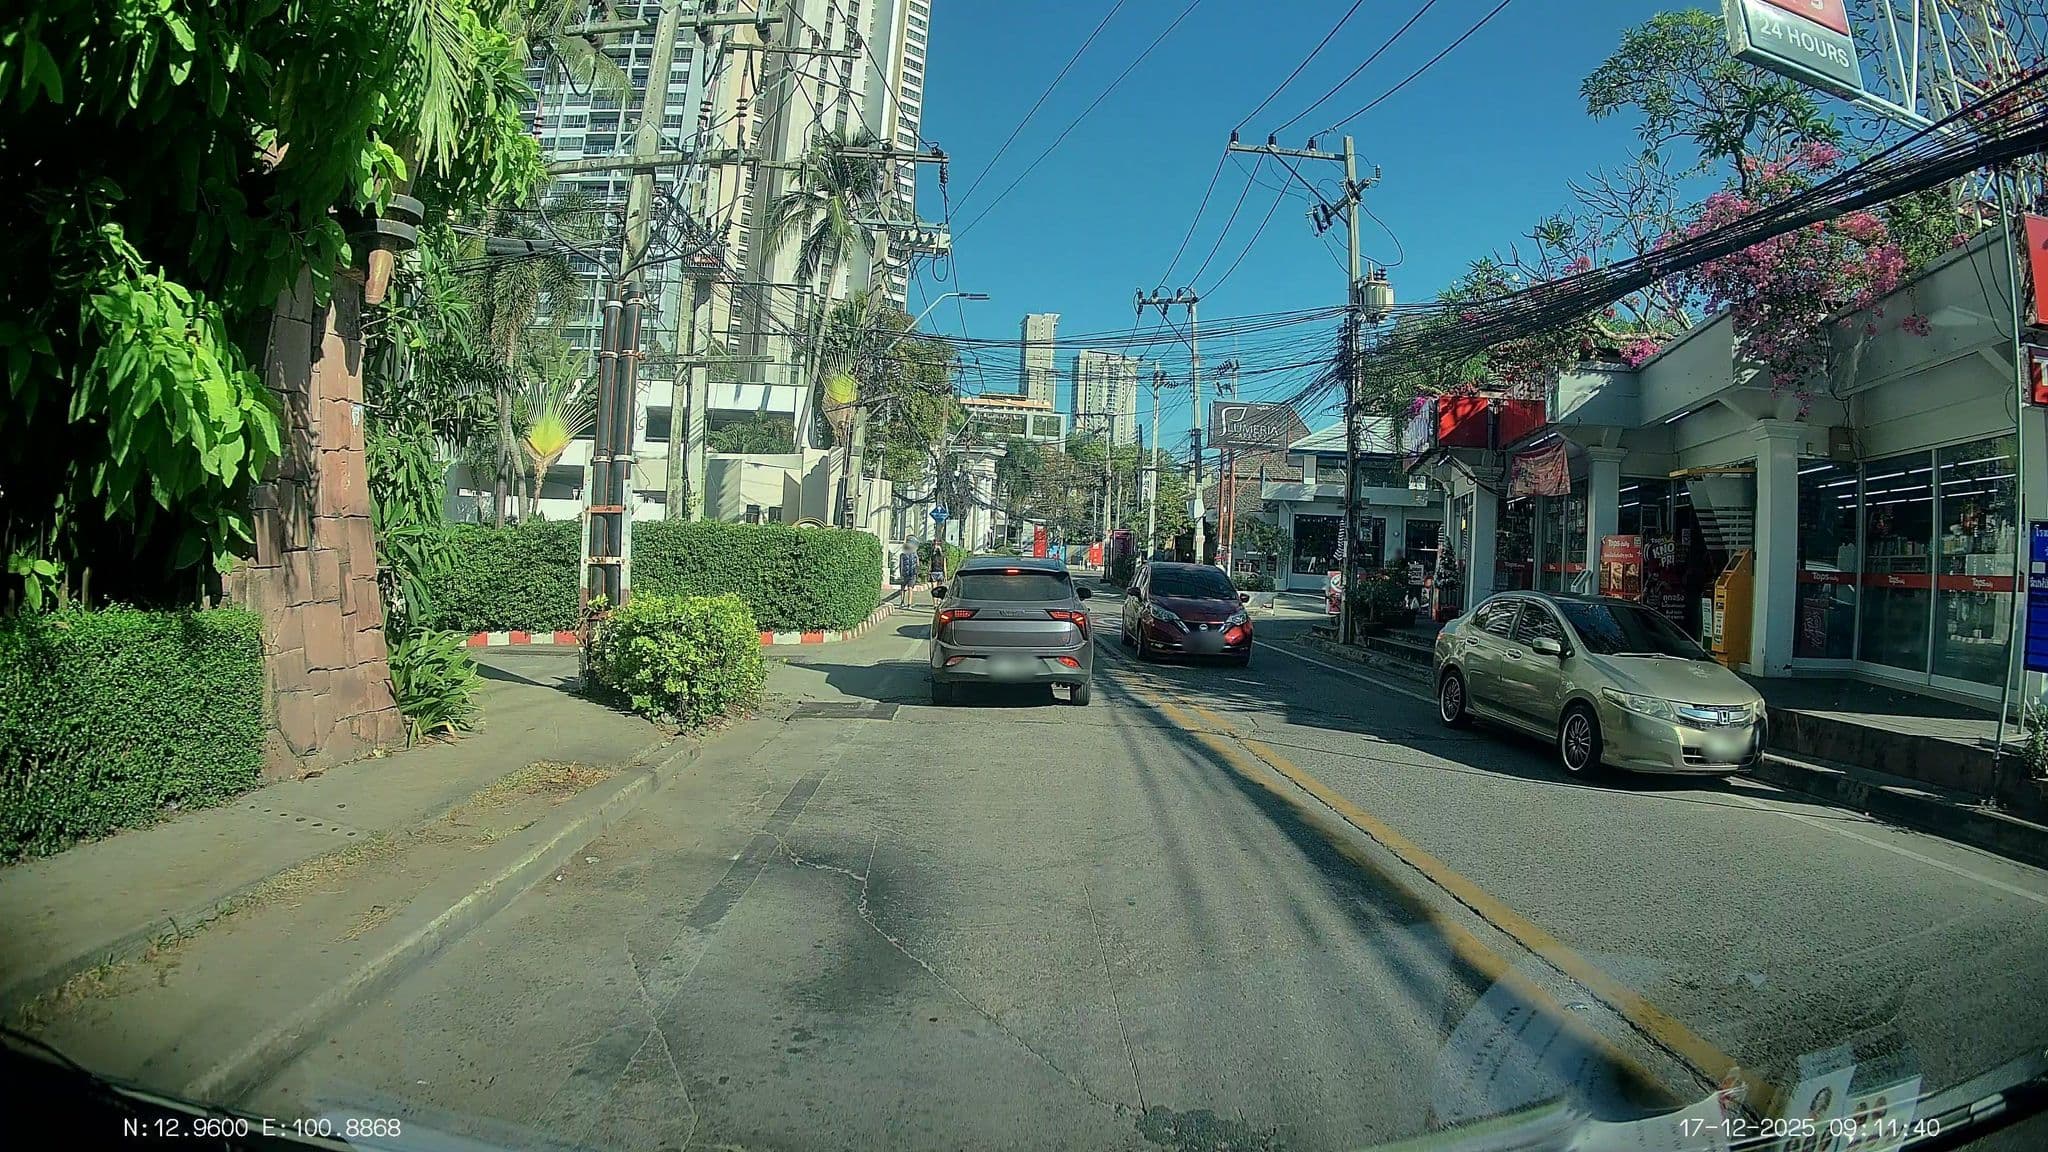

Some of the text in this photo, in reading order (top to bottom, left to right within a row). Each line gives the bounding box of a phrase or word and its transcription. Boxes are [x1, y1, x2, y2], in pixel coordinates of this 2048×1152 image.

[1760, 18, 1850, 68] 24 HOURS
[1811, 571, 1830, 582] Tops
